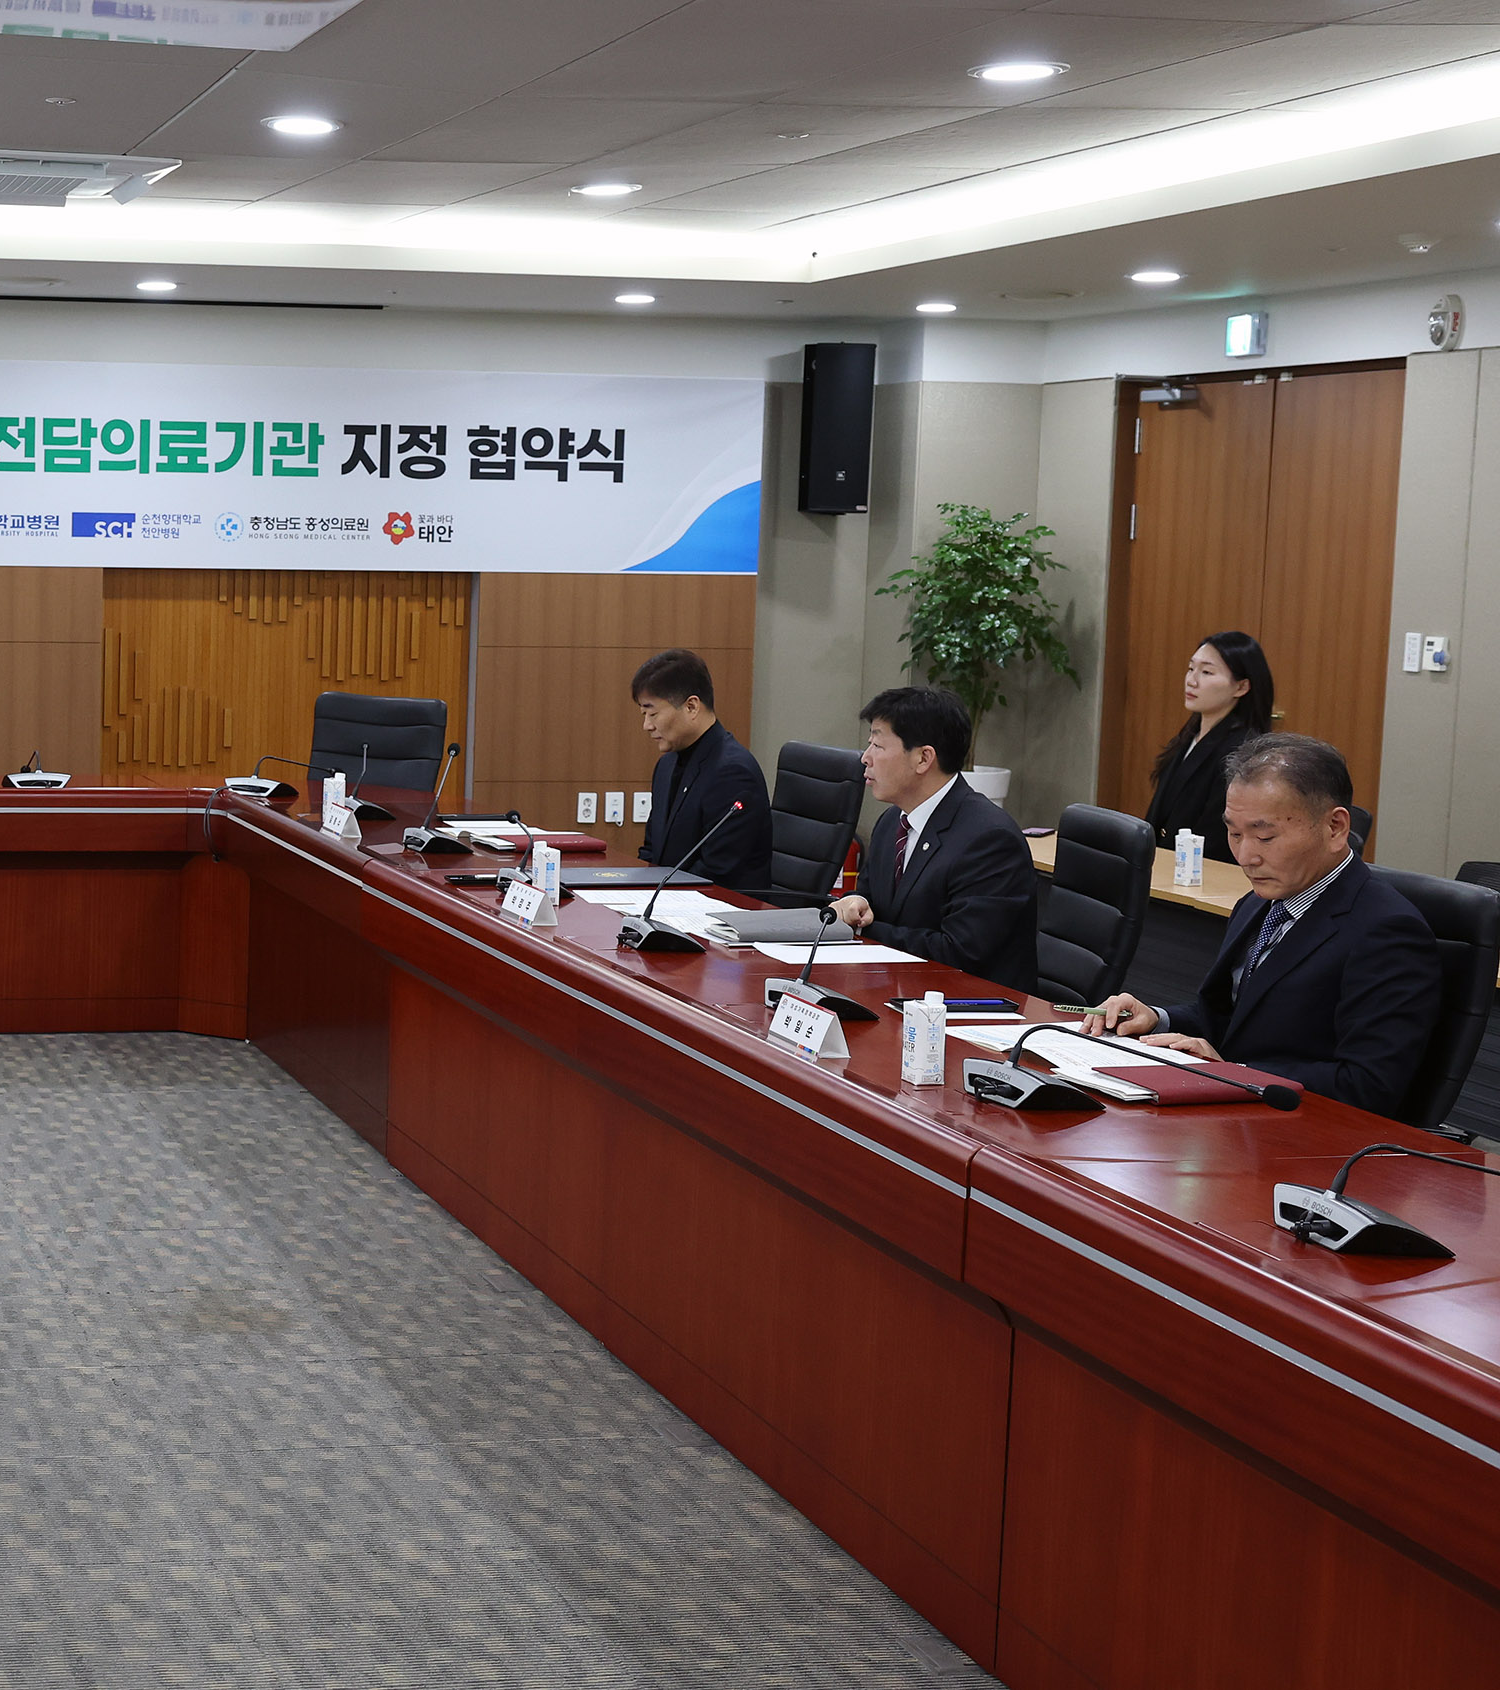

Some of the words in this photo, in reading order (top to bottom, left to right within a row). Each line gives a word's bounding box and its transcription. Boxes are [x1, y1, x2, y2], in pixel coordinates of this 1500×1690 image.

[340, 423, 448, 480] 지정
[466, 424, 626, 484] 협약식
[141, 513, 202, 525] 순천향대학교
[250, 516, 301, 531] 충청남도
[305, 517, 369, 532] 홍성의료원
[418, 514, 434, 525] 꽃과
[436, 514, 454, 524] 바다
[94, 521, 135, 538] SCH
[140, 527, 180, 539] 천안병원
[418, 525, 454, 543] 태안
[993, 1070, 1012, 1081] BOSCH
[1311, 1201, 1333, 1217] BOSCH
